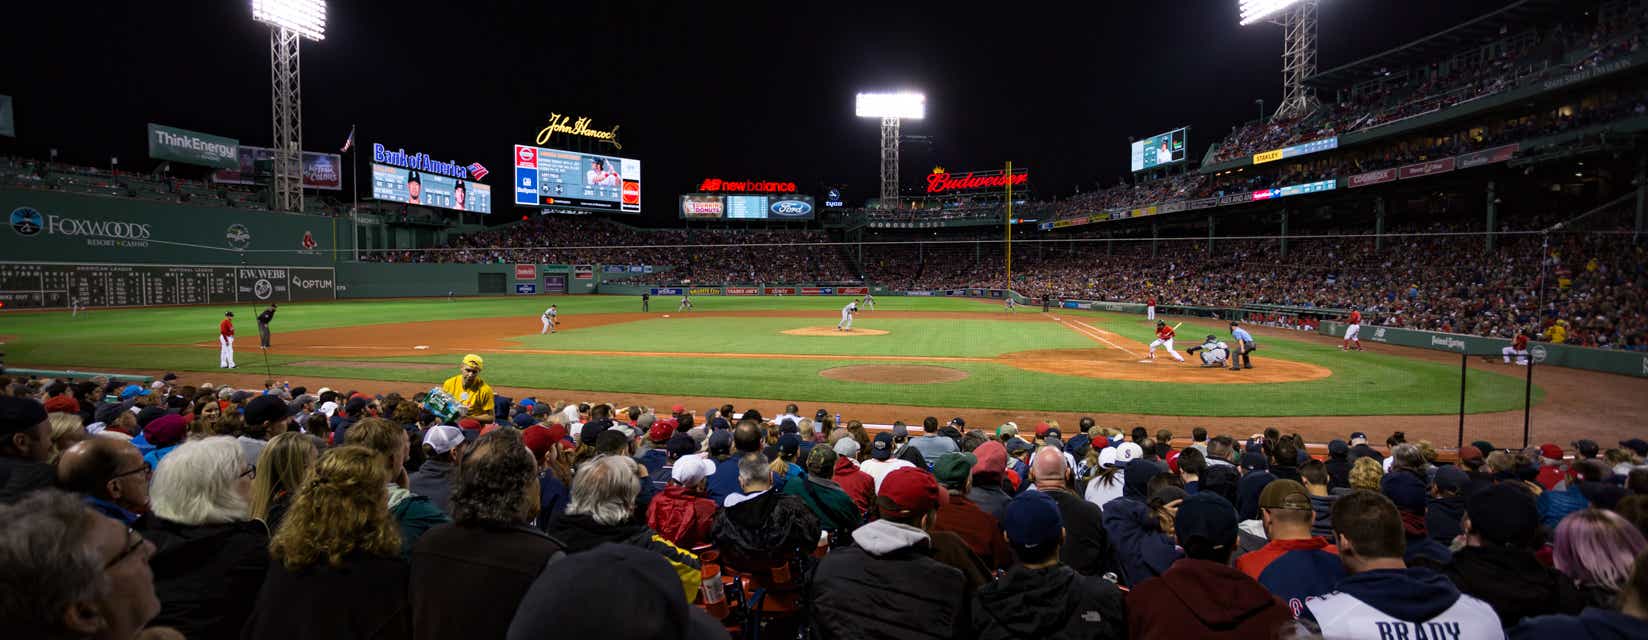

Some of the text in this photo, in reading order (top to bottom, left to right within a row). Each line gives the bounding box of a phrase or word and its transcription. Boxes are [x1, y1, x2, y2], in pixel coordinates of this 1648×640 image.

[536, 112, 623, 149] John Hancock
[374, 142, 467, 178] Bank of America
[927, 172, 1028, 192] Budweiser
[779, 202, 803, 213] Ford
[48, 215, 152, 238] FOXWOODS
[302, 280, 332, 289] OPTUM
[1374, 621, 1461, 640] BRADY
